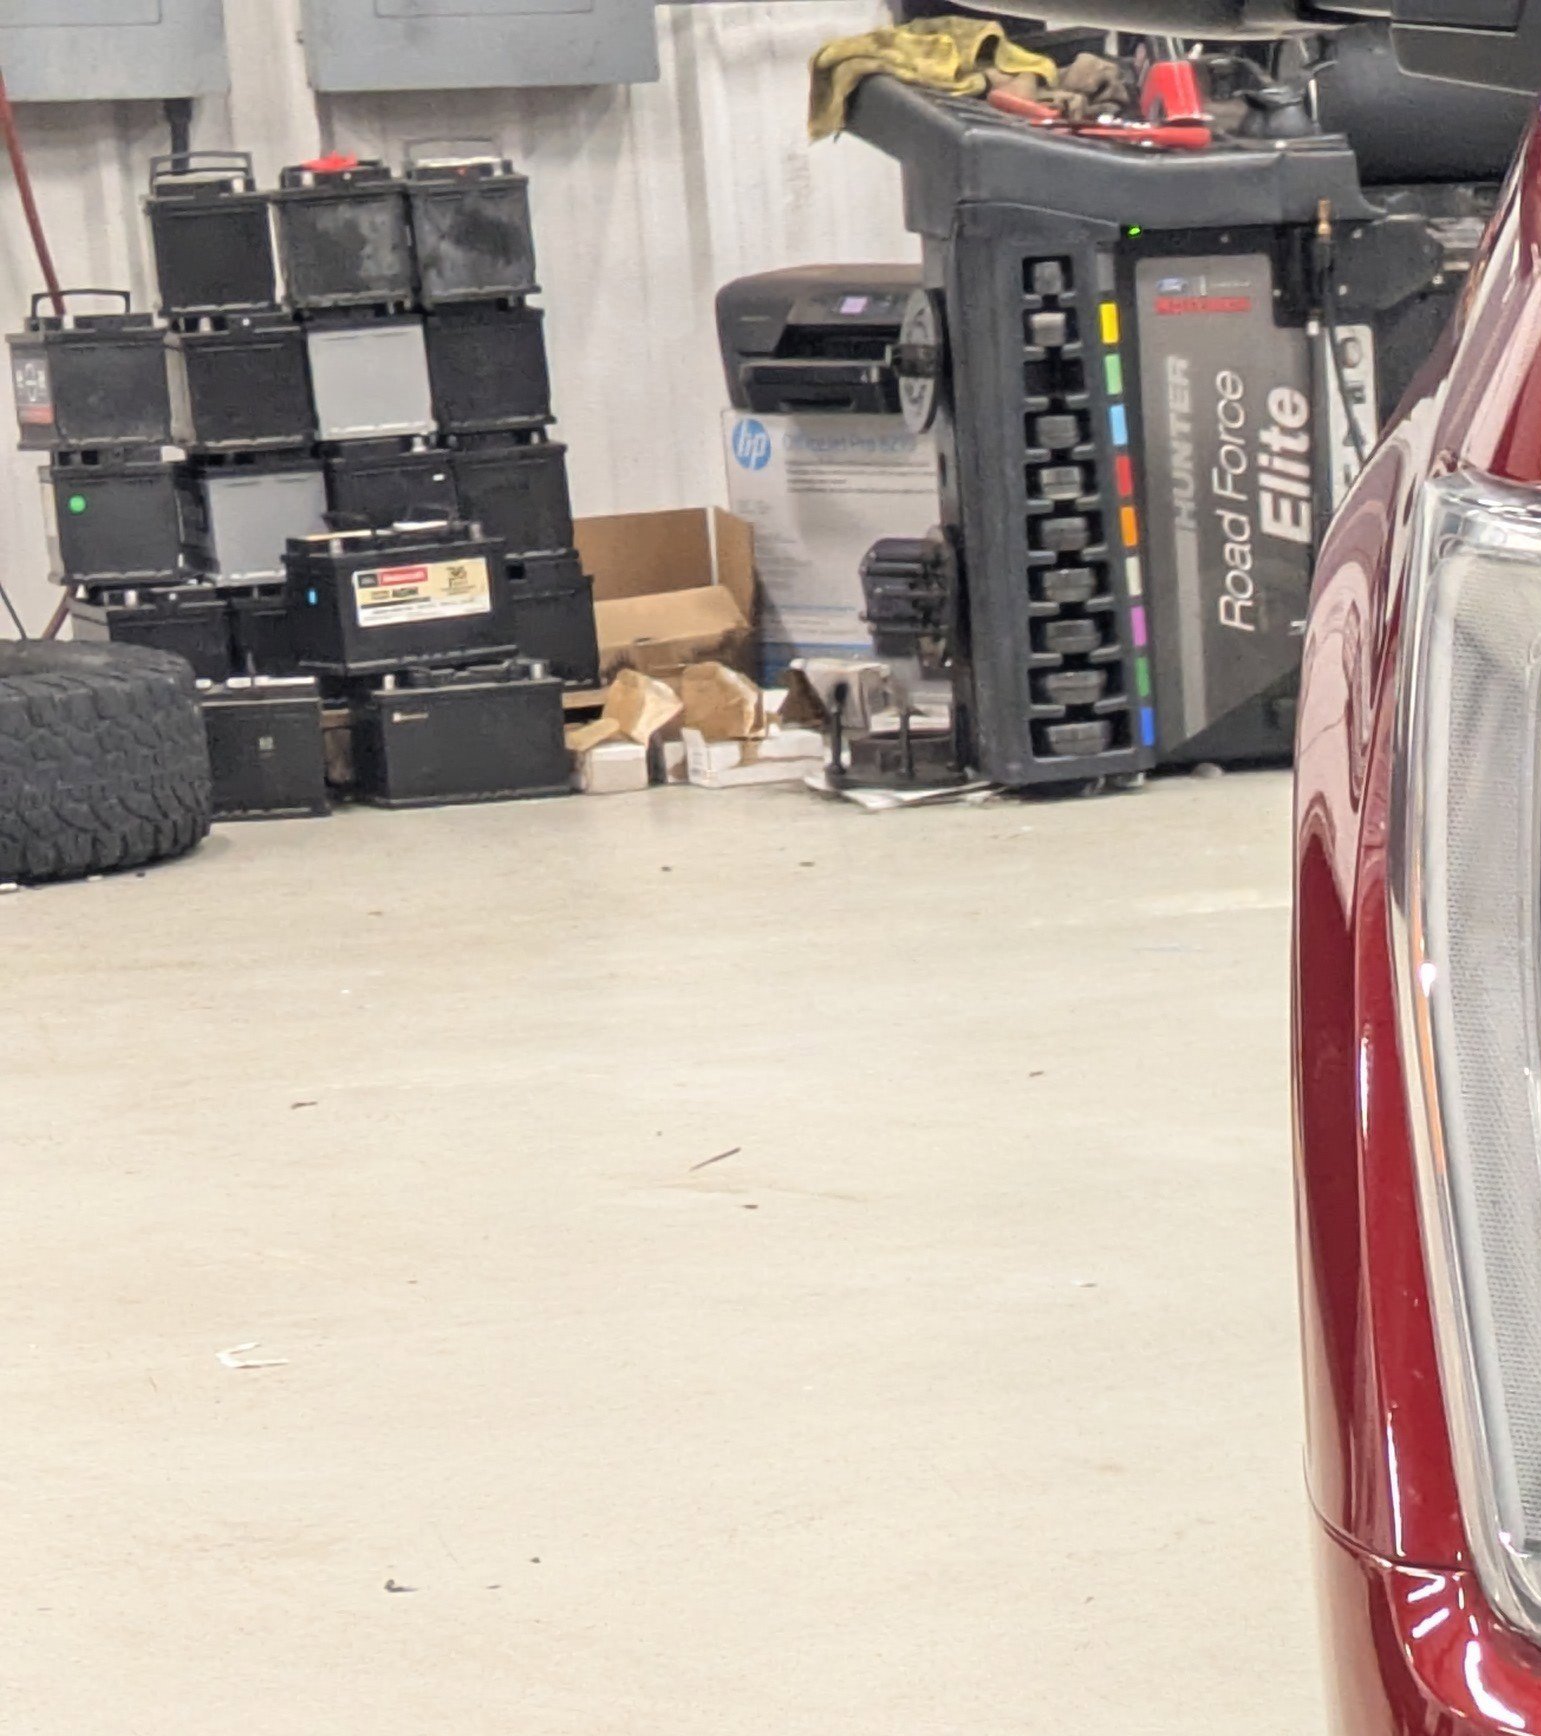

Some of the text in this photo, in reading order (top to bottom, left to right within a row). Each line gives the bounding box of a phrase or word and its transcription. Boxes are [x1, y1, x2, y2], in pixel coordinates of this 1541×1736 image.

[735, 419, 770, 470] hp
[1166, 355, 1197, 533] HUNTER
[1211, 369, 1255, 632] Road Force
[1257, 386, 1314, 543] Elite
